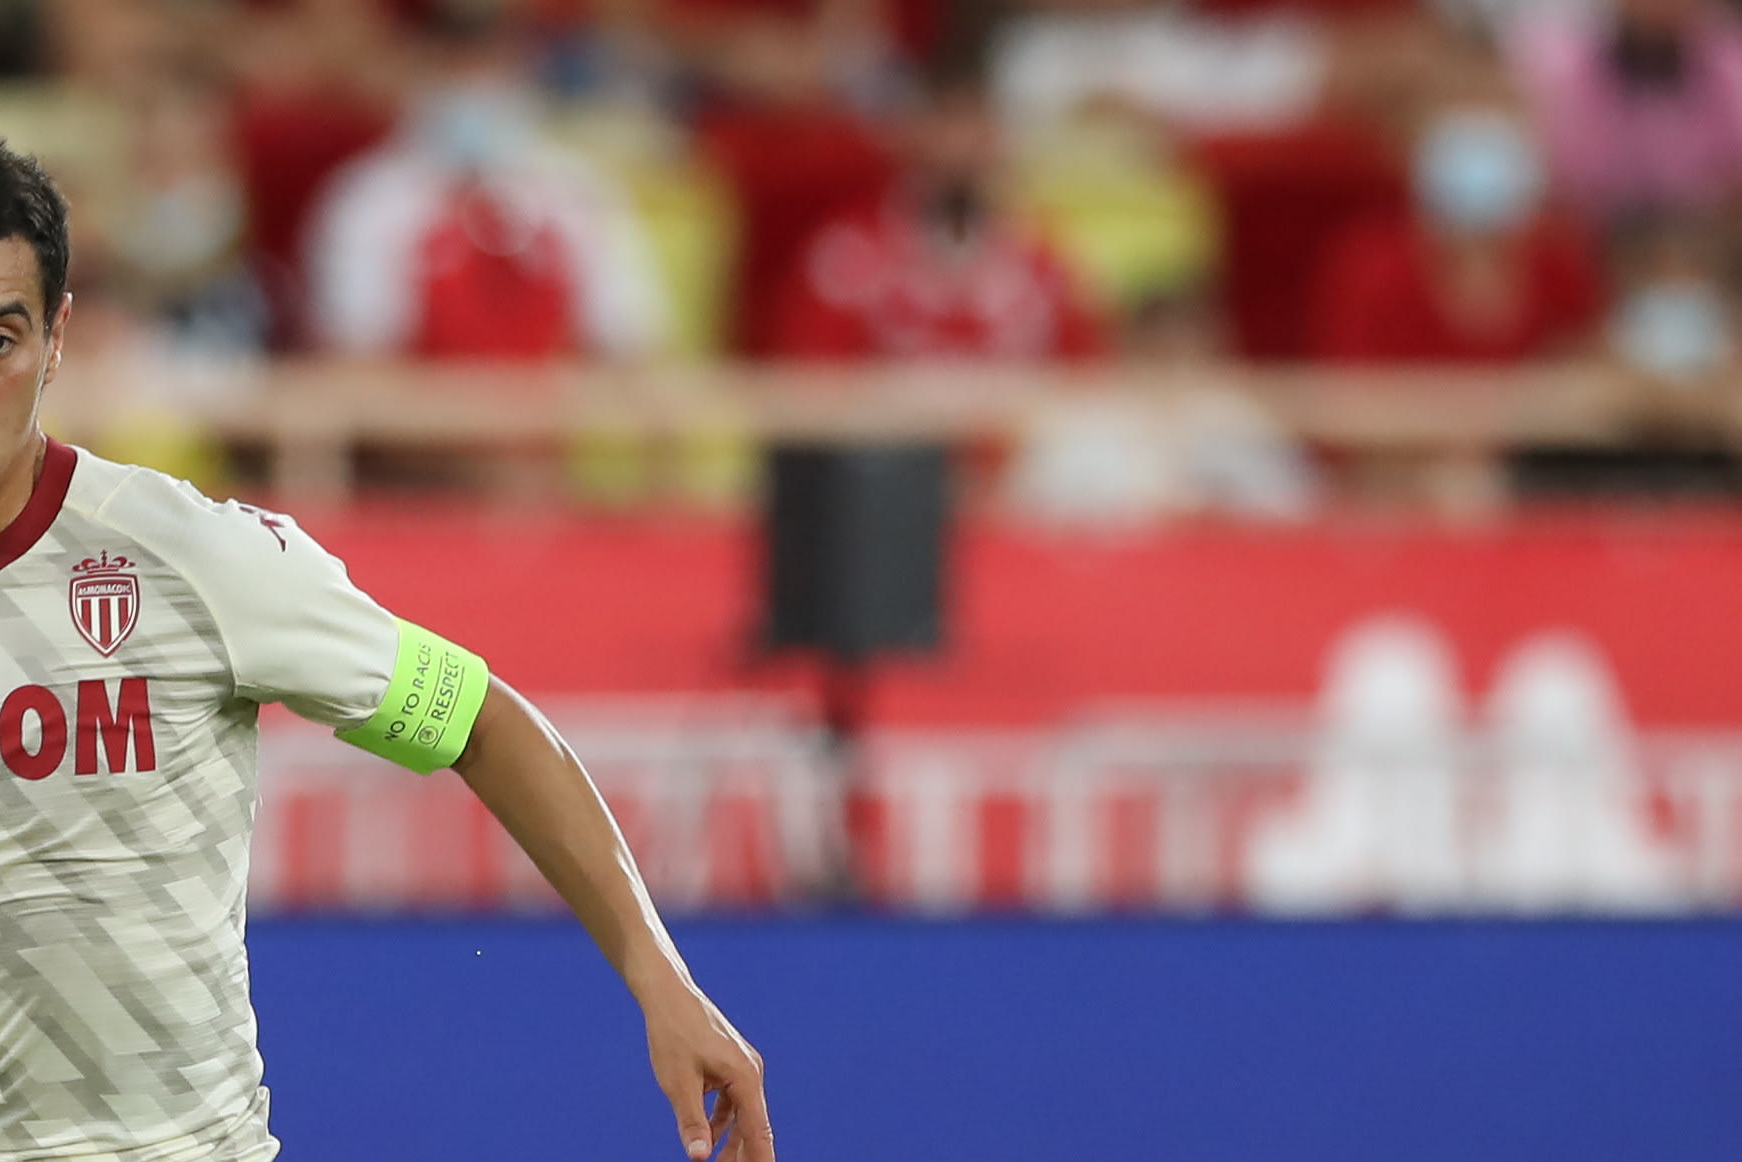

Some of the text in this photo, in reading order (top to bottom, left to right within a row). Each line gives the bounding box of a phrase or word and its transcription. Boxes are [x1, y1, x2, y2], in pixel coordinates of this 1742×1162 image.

[431, 651, 459, 720] RESPECT
[385, 720, 406, 741] NO
[401, 693, 420, 716] TO
